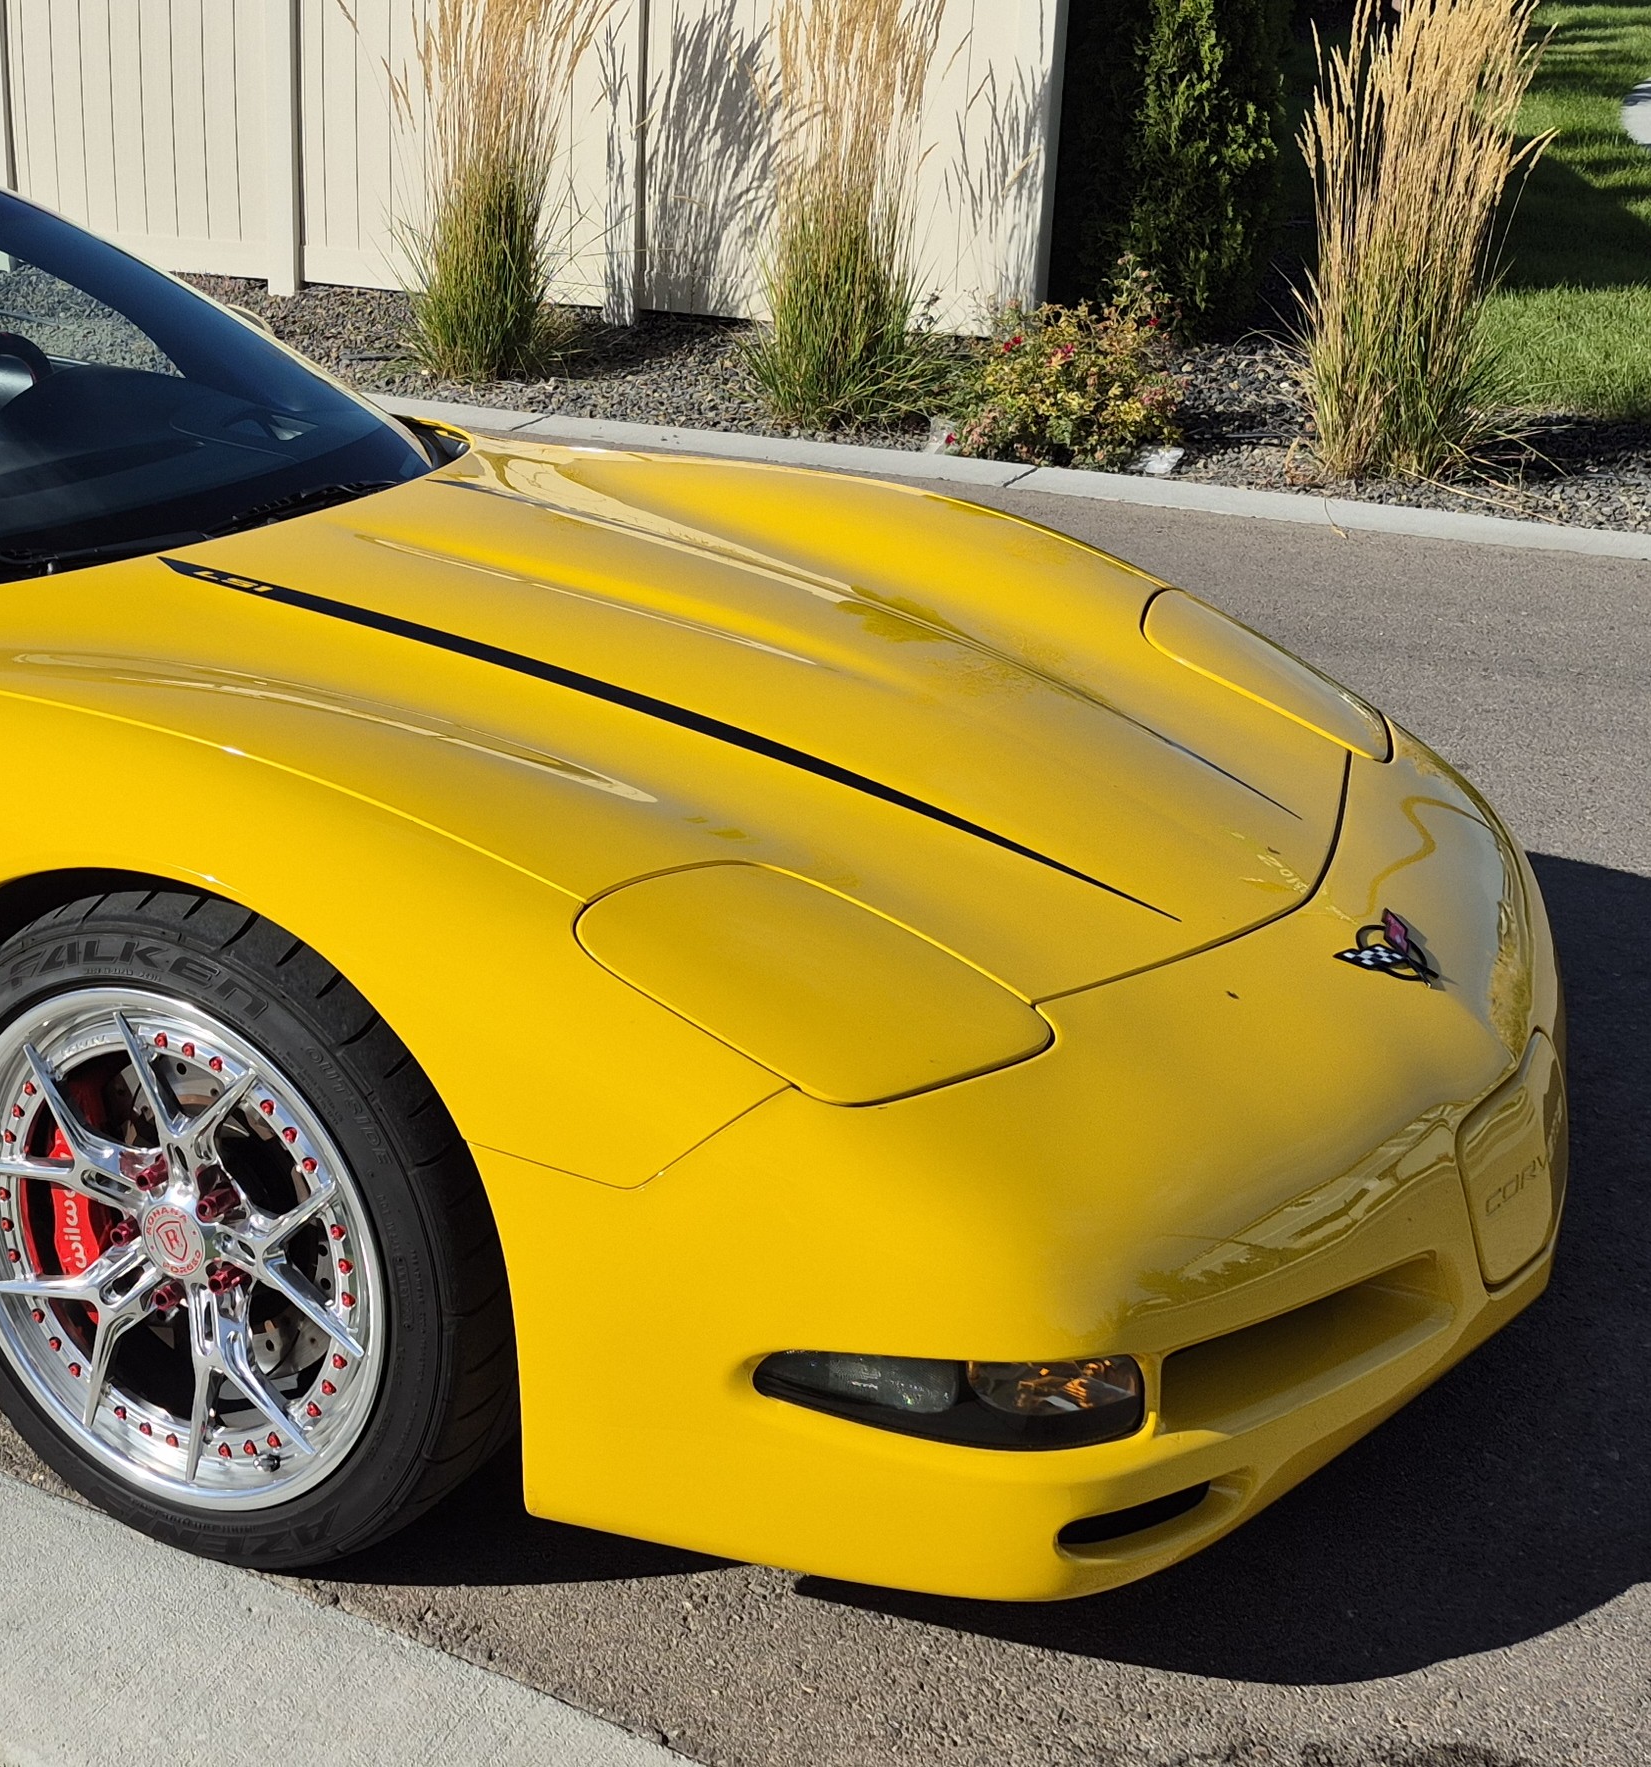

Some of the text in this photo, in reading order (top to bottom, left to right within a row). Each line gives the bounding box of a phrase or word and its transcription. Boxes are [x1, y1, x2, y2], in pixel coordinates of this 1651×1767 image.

[193, 571, 273, 593] LS1
[1, 939, 269, 1021] FALKEN
[305, 1045, 394, 1165] OUTSIDE
